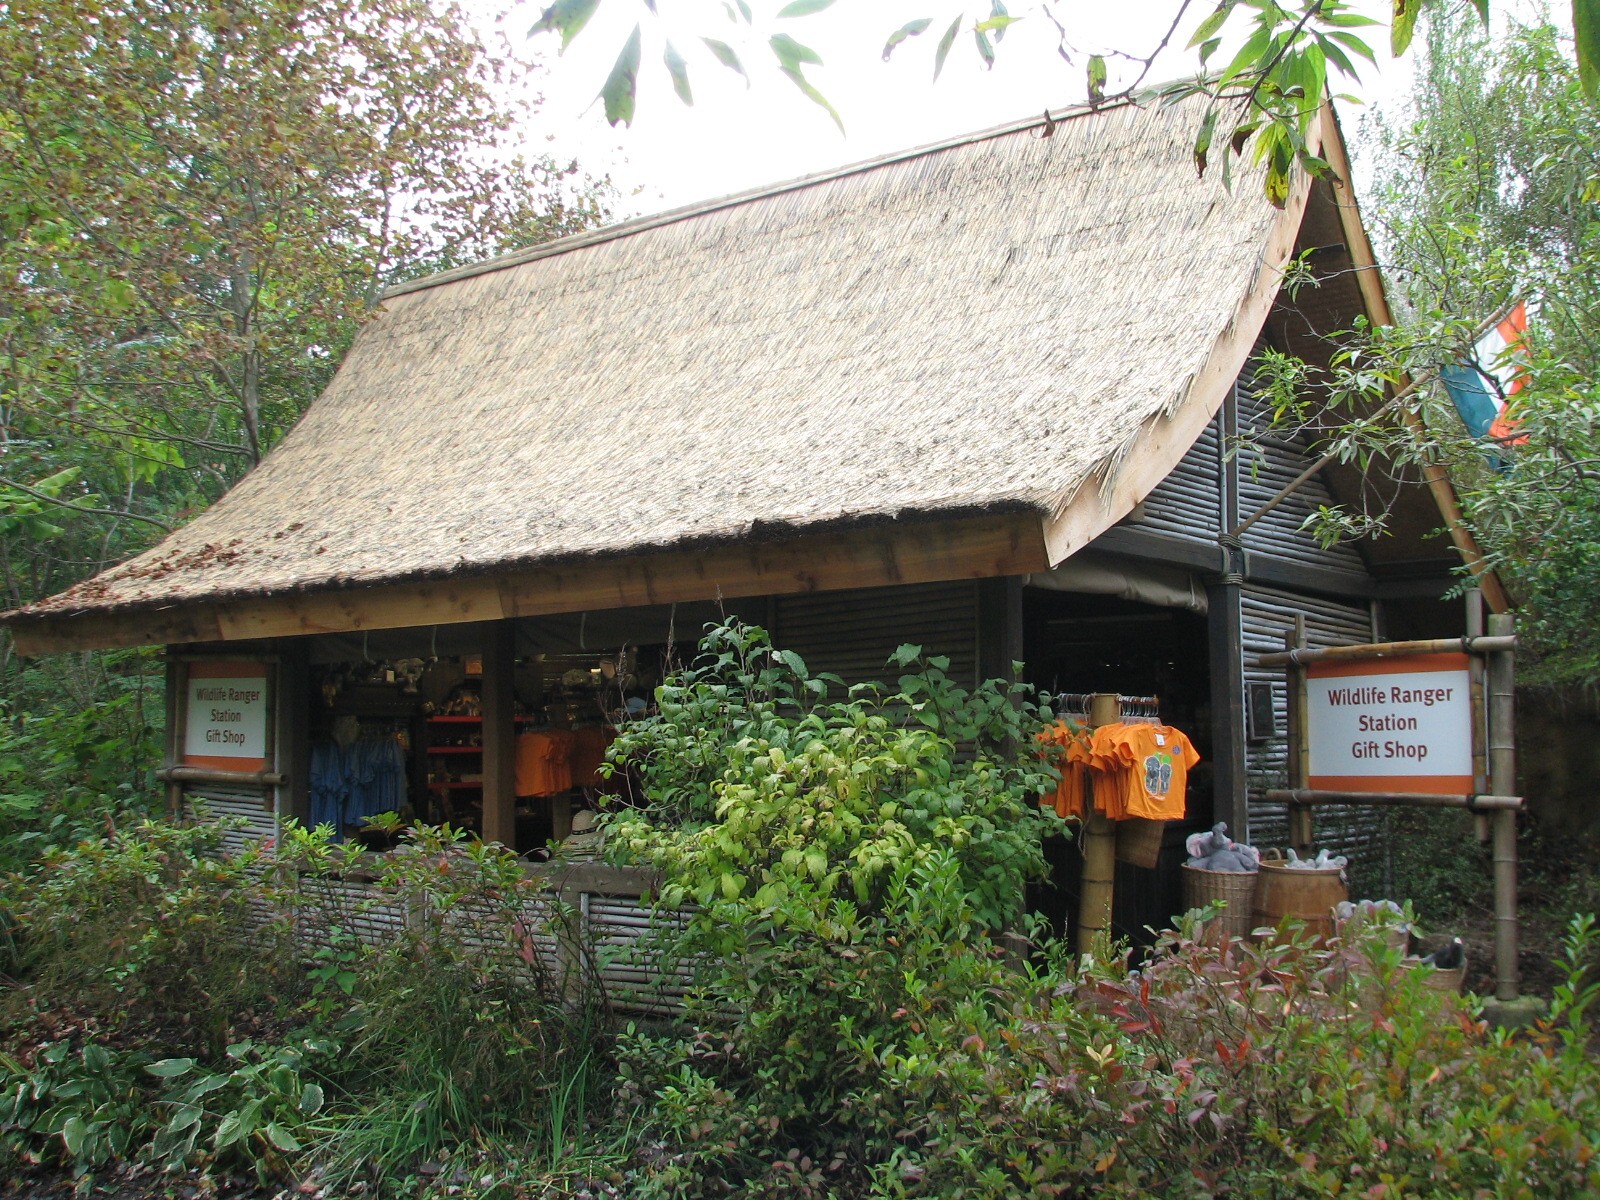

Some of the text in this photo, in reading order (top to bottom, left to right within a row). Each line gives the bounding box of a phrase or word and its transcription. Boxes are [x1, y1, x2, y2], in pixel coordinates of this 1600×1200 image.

[196, 688, 260, 704] Wildlife Ranger
[1328, 686, 1453, 707] Wildlife Ranger
[211, 709, 241, 722] Station
[1359, 714, 1418, 732] Station
[206, 729, 246, 747] Gift Shop
[1352, 741, 1428, 762] Gift Shop
